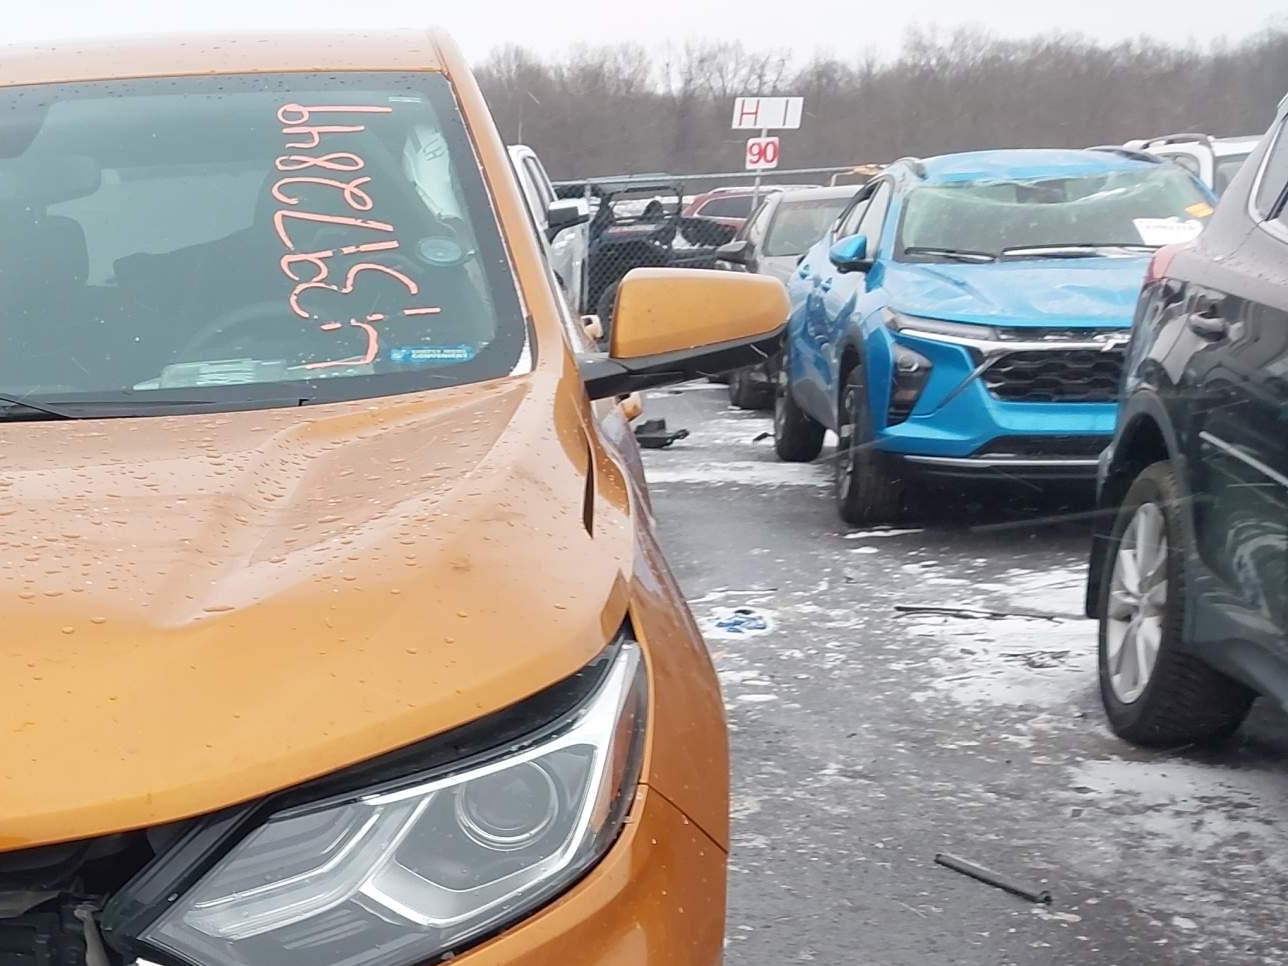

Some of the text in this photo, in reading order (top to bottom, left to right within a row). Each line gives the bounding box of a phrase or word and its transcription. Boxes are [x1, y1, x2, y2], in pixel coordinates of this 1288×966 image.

[738, 98, 760, 127] H
[748, 141, 778, 164] 90
[271, 102, 441, 370] 43972849
